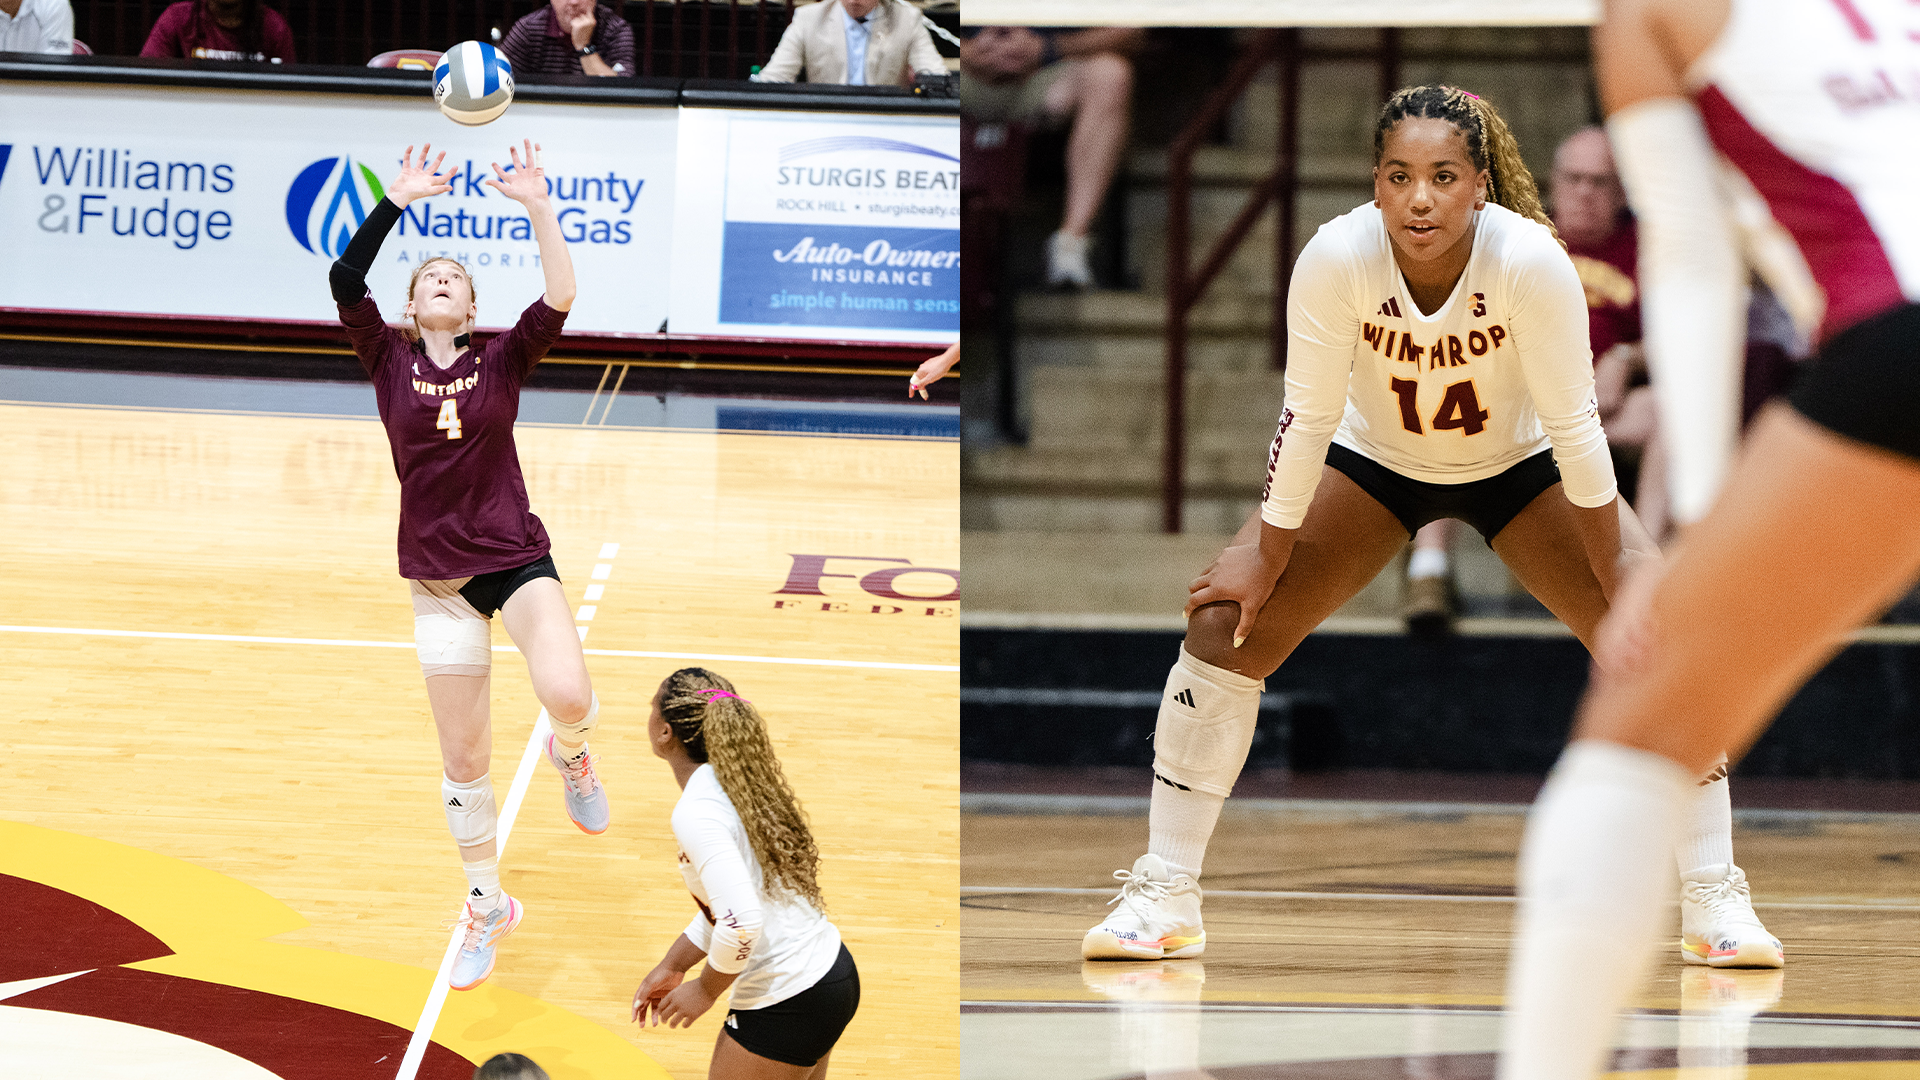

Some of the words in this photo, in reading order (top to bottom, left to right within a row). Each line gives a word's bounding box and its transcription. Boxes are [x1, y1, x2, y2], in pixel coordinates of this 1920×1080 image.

[33, 145, 235, 193] Williams
[777, 166, 887, 188] STURGIS
[37, 194, 233, 250] &Fudge
[398, 203, 540, 241] Natura
[556, 207, 632, 245] Gas
[776, 198, 815, 212] ROCK
[817, 200, 847, 213] HILL
[812, 268, 932, 287] INSURANCE
[770, 289, 836, 312] simple
[841, 292, 909, 312] human
[1363, 321, 1507, 374] WINTHROP
[436, 398, 462, 440] 4
[1389, 372, 1491, 438] 14
[772, 599, 953, 618] FEDE
